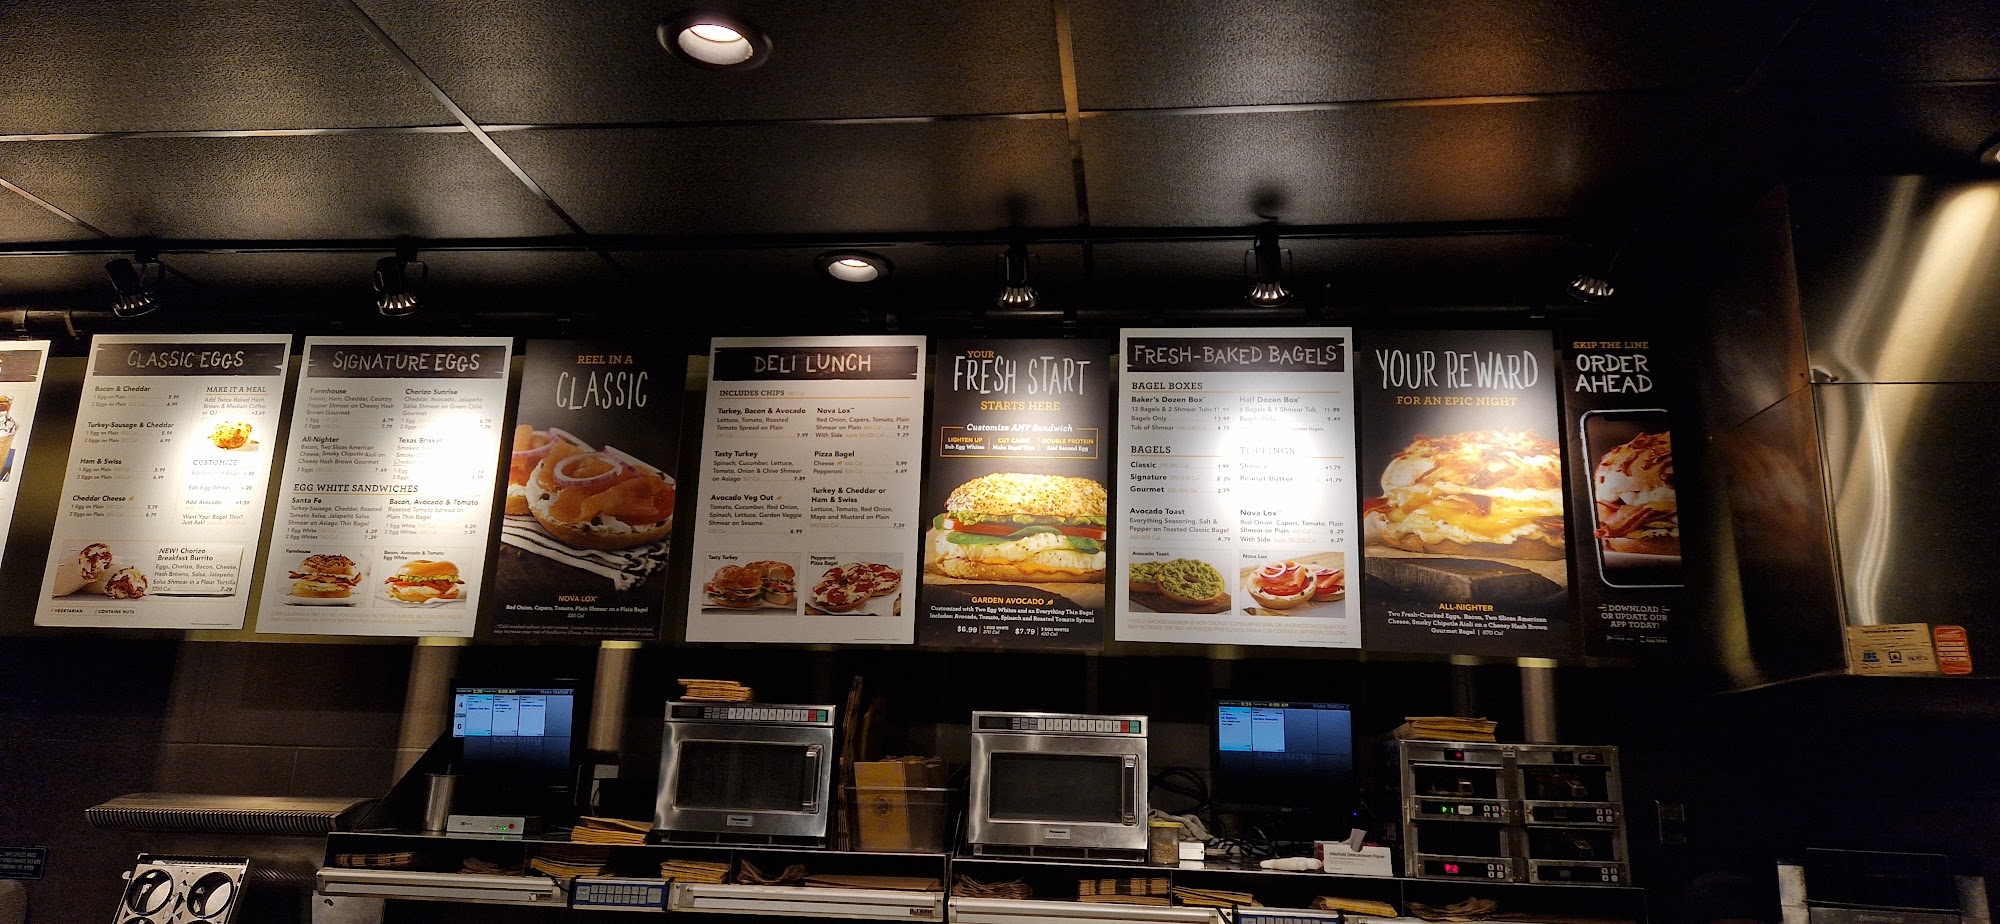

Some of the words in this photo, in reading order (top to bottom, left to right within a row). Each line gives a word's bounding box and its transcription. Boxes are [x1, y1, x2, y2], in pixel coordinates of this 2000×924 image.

[128, 350, 194, 367] CLASSIC
[200, 351, 245, 369] EGGS
[333, 351, 430, 372] SIGNATURE
[435, 353, 480, 372] EGGS
[577, 356, 605, 364] REEL
[609, 356, 621, 364] IN
[625, 356, 633, 364] A
[754, 355, 796, 373] DELI
[806, 354, 871, 372] LUNCH
[1135, 345, 1262, 365] FRESH-BAKED
[1269, 346, 1336, 365] BAGELS
[1576, 354, 1649, 372] ORDER
[954, 356, 1016, 394] FRESH
[1028, 356, 1090, 395] START
[1376, 349, 1438, 389] YOUR
[1444, 351, 1539, 389] REWARD
[556, 371, 648, 409] CLASSIC
[1132, 382, 1165, 390] BAGEL
[1169, 382, 1203, 390] BOXES
[1575, 375, 1652, 393] AHEAD
[981, 401, 1024, 410] STARTS
[1028, 402, 1060, 411] HERE
[1397, 396, 1420, 405] FOR
[1424, 397, 1441, 405] AN
[1445, 397, 1473, 406] EPIC
[1476, 398, 1517, 407] NIGHT
[1131, 446, 1171, 454] BAGELS
[317, 484, 349, 492] WHITE
[812, 487, 836, 495] Turkey
[1439, 603, 1493, 611] ALL-NIGHTER
